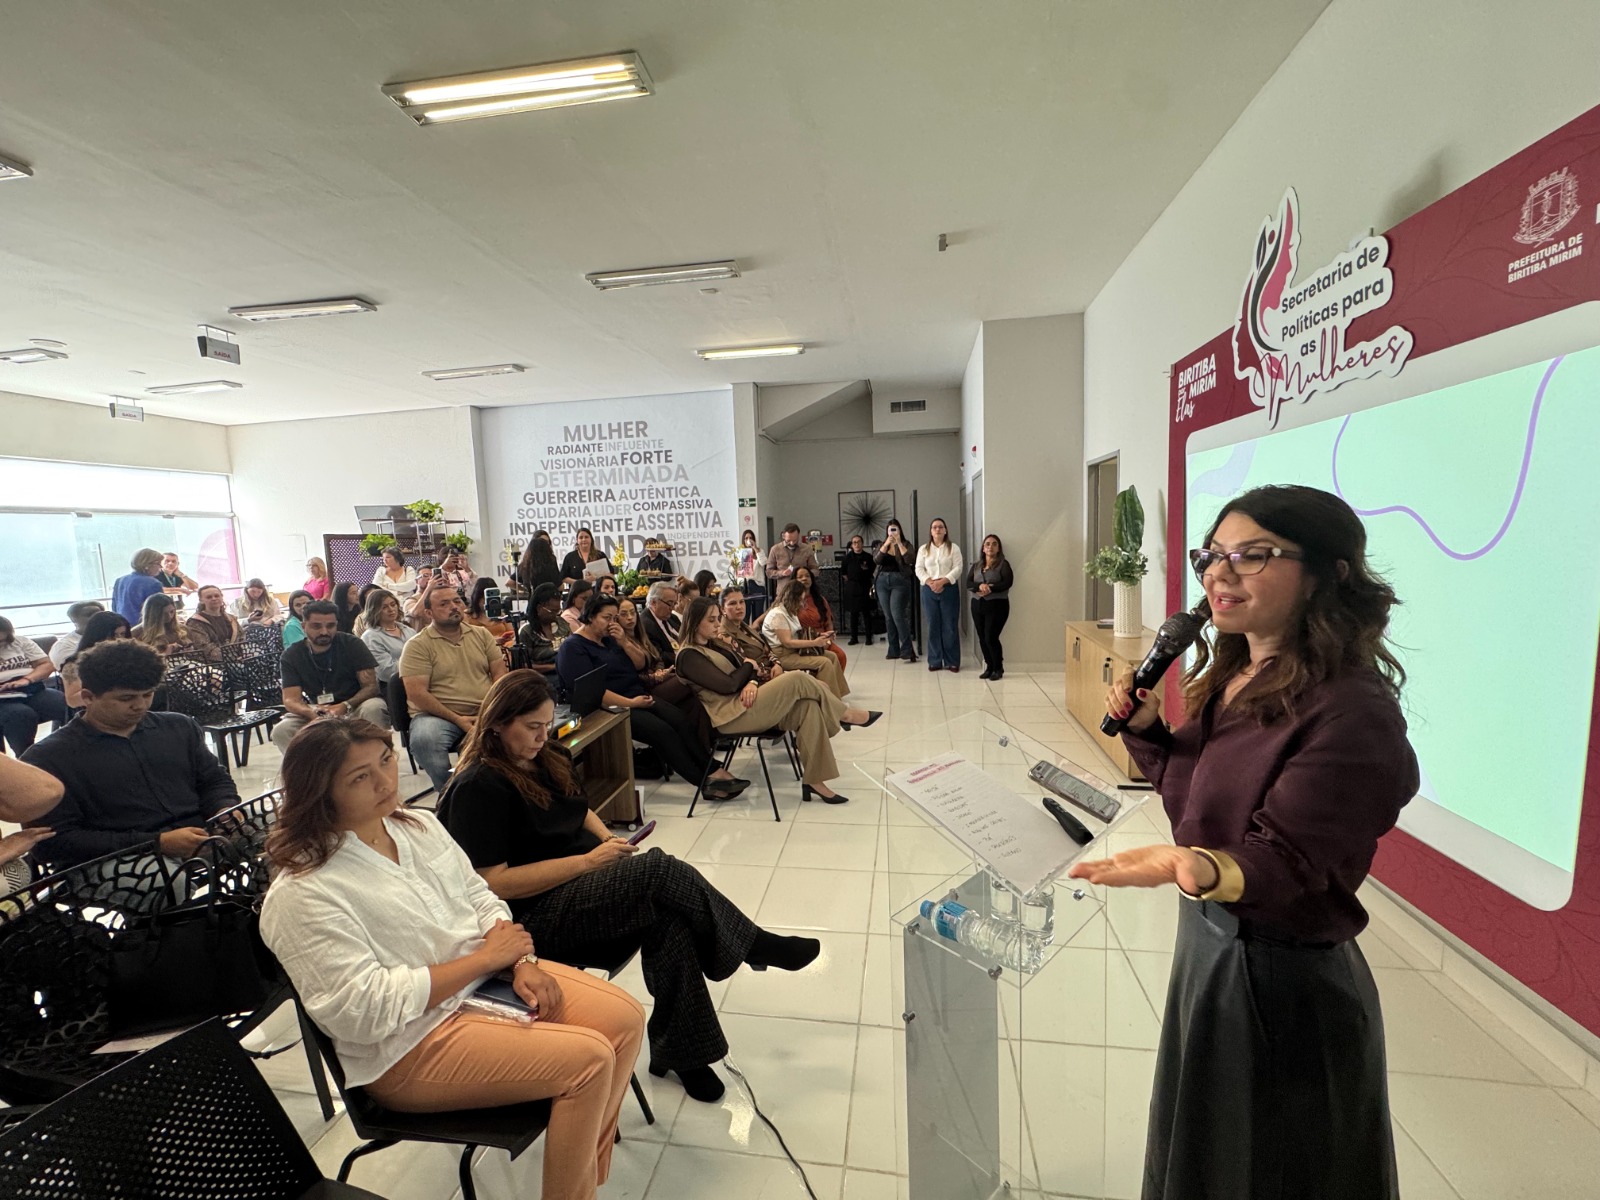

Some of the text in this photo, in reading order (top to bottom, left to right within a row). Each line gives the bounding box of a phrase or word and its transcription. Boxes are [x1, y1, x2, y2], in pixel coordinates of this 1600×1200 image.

[1508, 233, 1583, 272] PREFEITURA DE
[1508, 245, 1583, 283] BIRITIBA MIRIM
[1281, 246, 1380, 313] Secretaria de
[1281, 278, 1385, 342] Políticas para
[1300, 339, 1317, 357] as
[1178, 353, 1216, 389] BIRITIBA
[1253, 325, 1405, 421] Mulheres
[1188, 371, 1217, 400] MIRIM
[563, 420, 649, 442] MULHER
[547, 439, 664, 456] RADIANTE INFLUENTE
[540, 450, 673, 471] VISIONÁRIA FORTE
[533, 464, 690, 489] DETERMINADA
[523, 485, 702, 506] GUERREIRA AUTÊNTICA
[516, 498, 713, 520] SOLIDARIA LIDER COMPASSIVA
[636, 510, 723, 531] ASSERTIVA
[667, 530, 731, 541] INDEPENDENTE
[674, 539, 736, 558] BELAS
